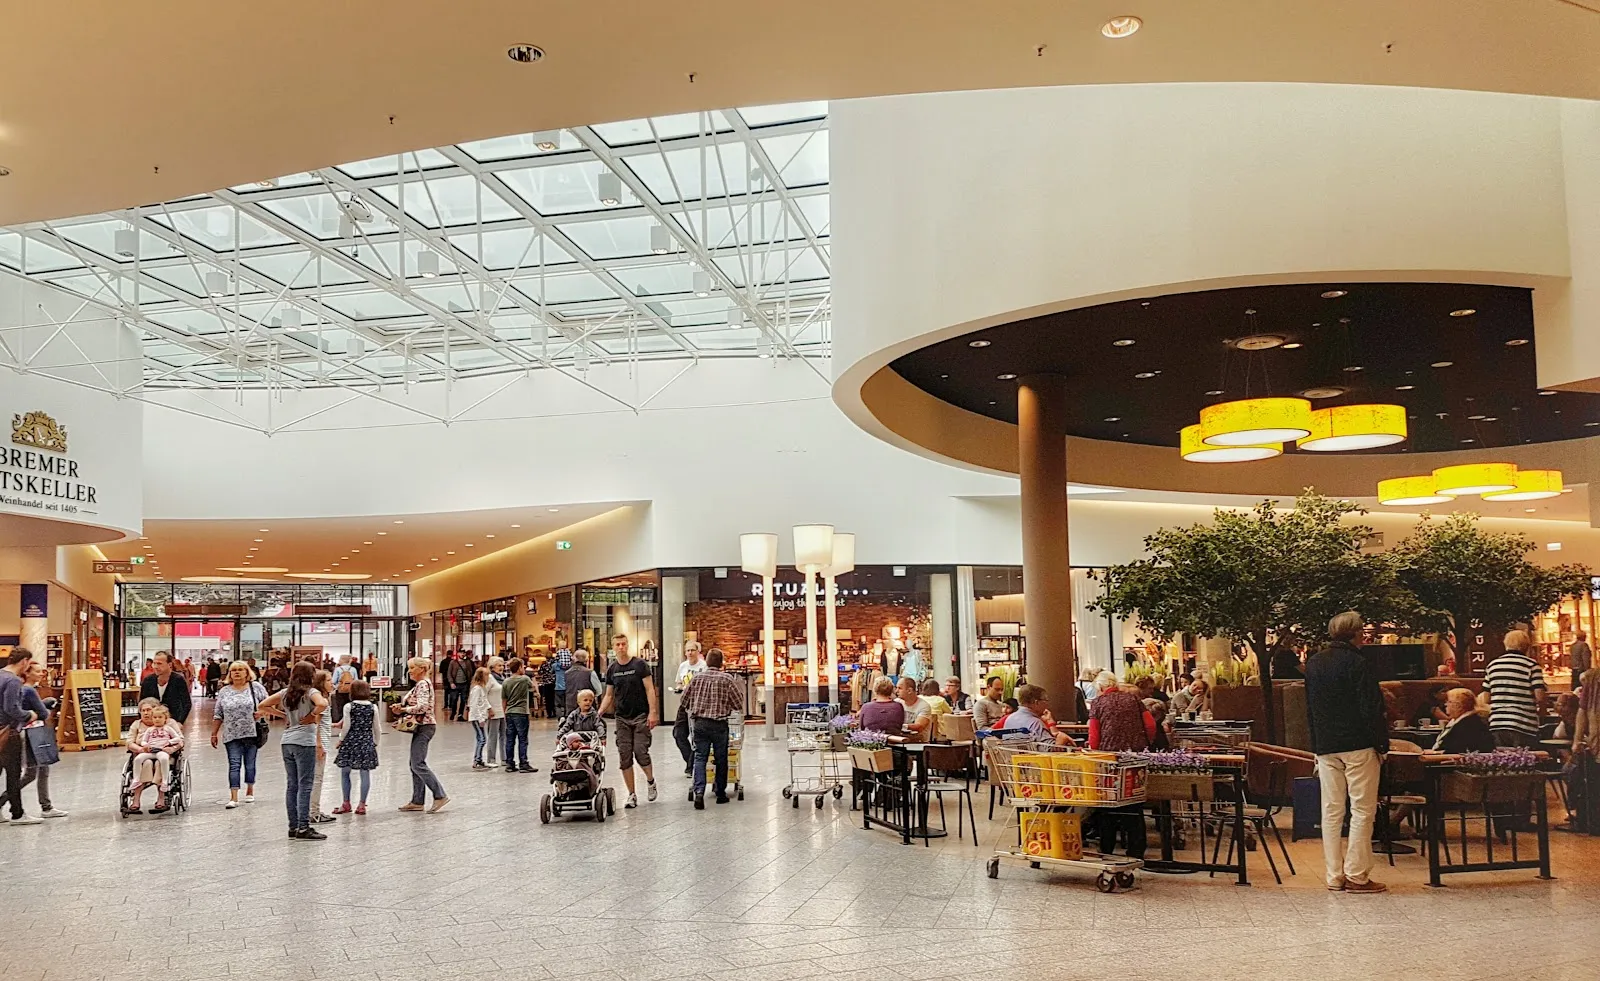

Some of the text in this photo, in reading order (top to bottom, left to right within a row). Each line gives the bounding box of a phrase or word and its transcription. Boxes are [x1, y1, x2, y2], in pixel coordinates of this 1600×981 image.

[0, 446, 80, 478] BREMER
[45, 502, 58, 511] seit
[60, 504, 78, 514] 1405
[751, 582, 869, 596] RTUALS...
